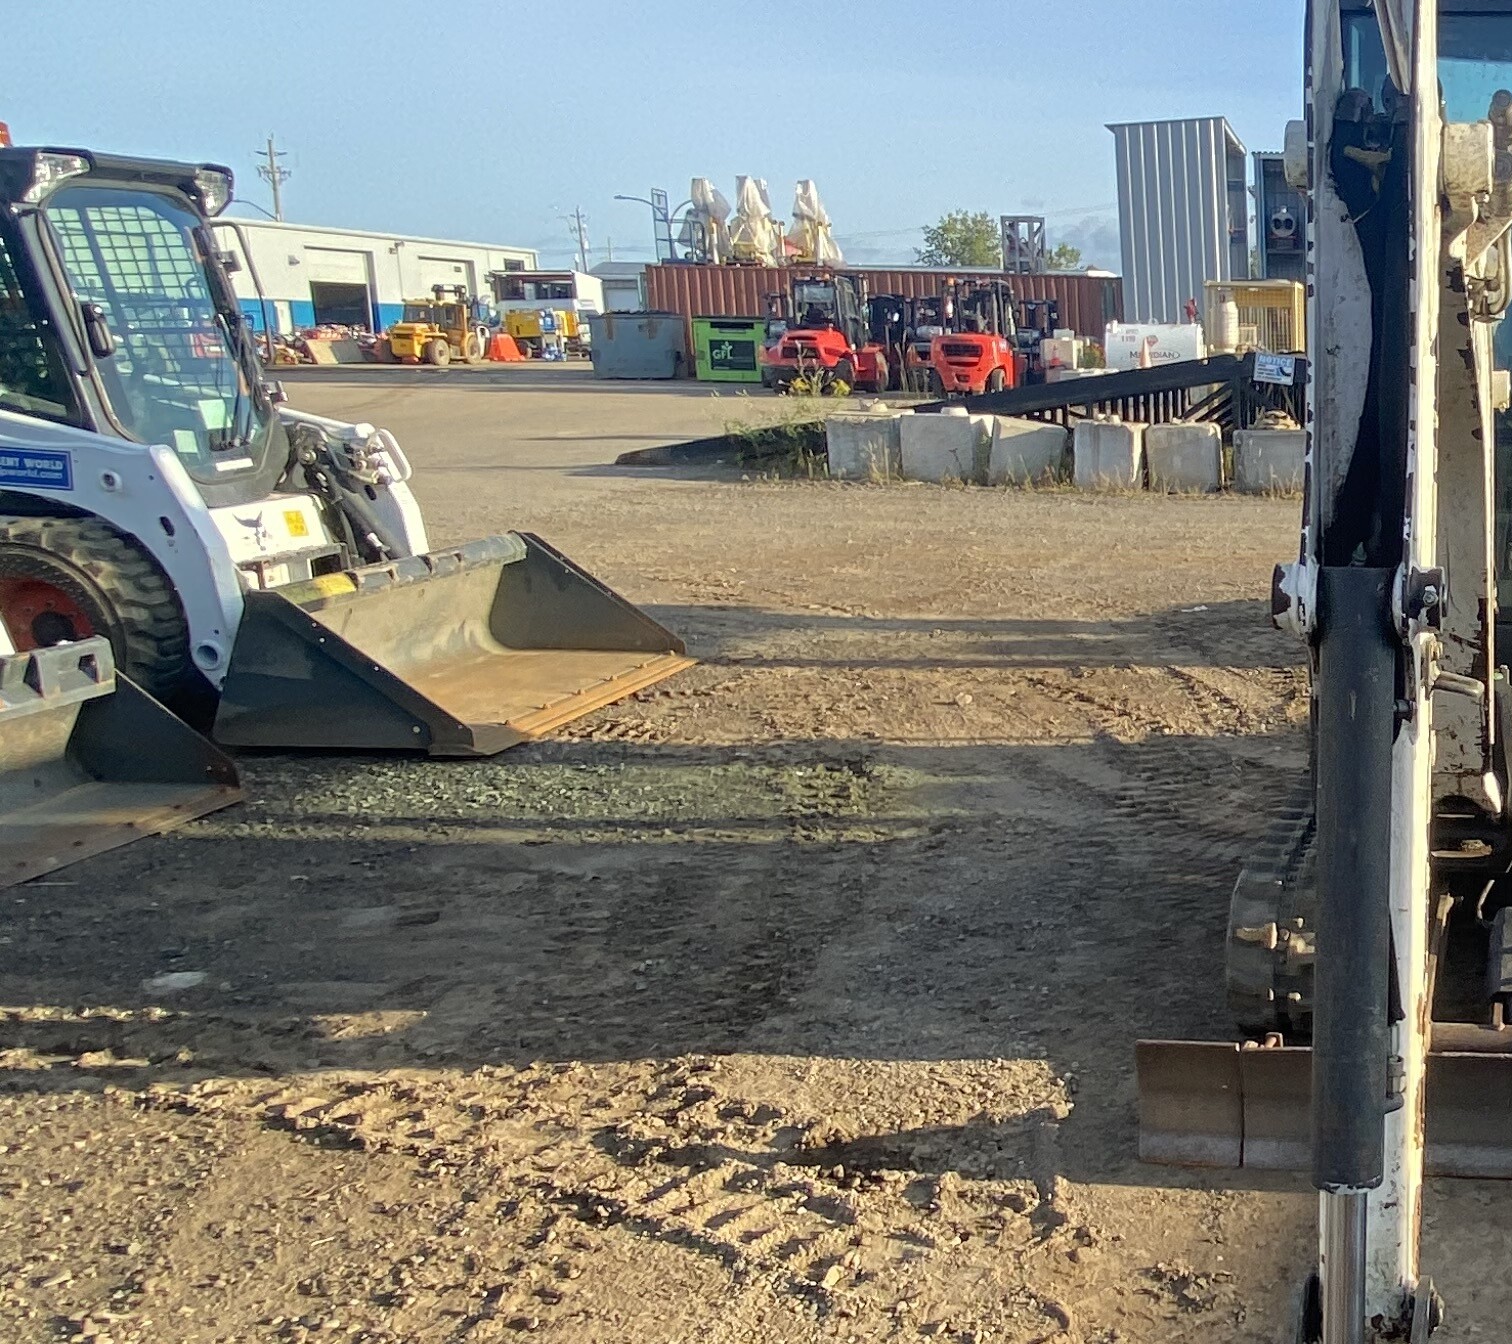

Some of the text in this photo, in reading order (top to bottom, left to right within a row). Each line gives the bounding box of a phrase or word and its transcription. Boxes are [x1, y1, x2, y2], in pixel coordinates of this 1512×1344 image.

[712, 346, 733, 360] GFL
[1258, 355, 1293, 367] NOTICE
[23, 458, 63, 470] WORLD
